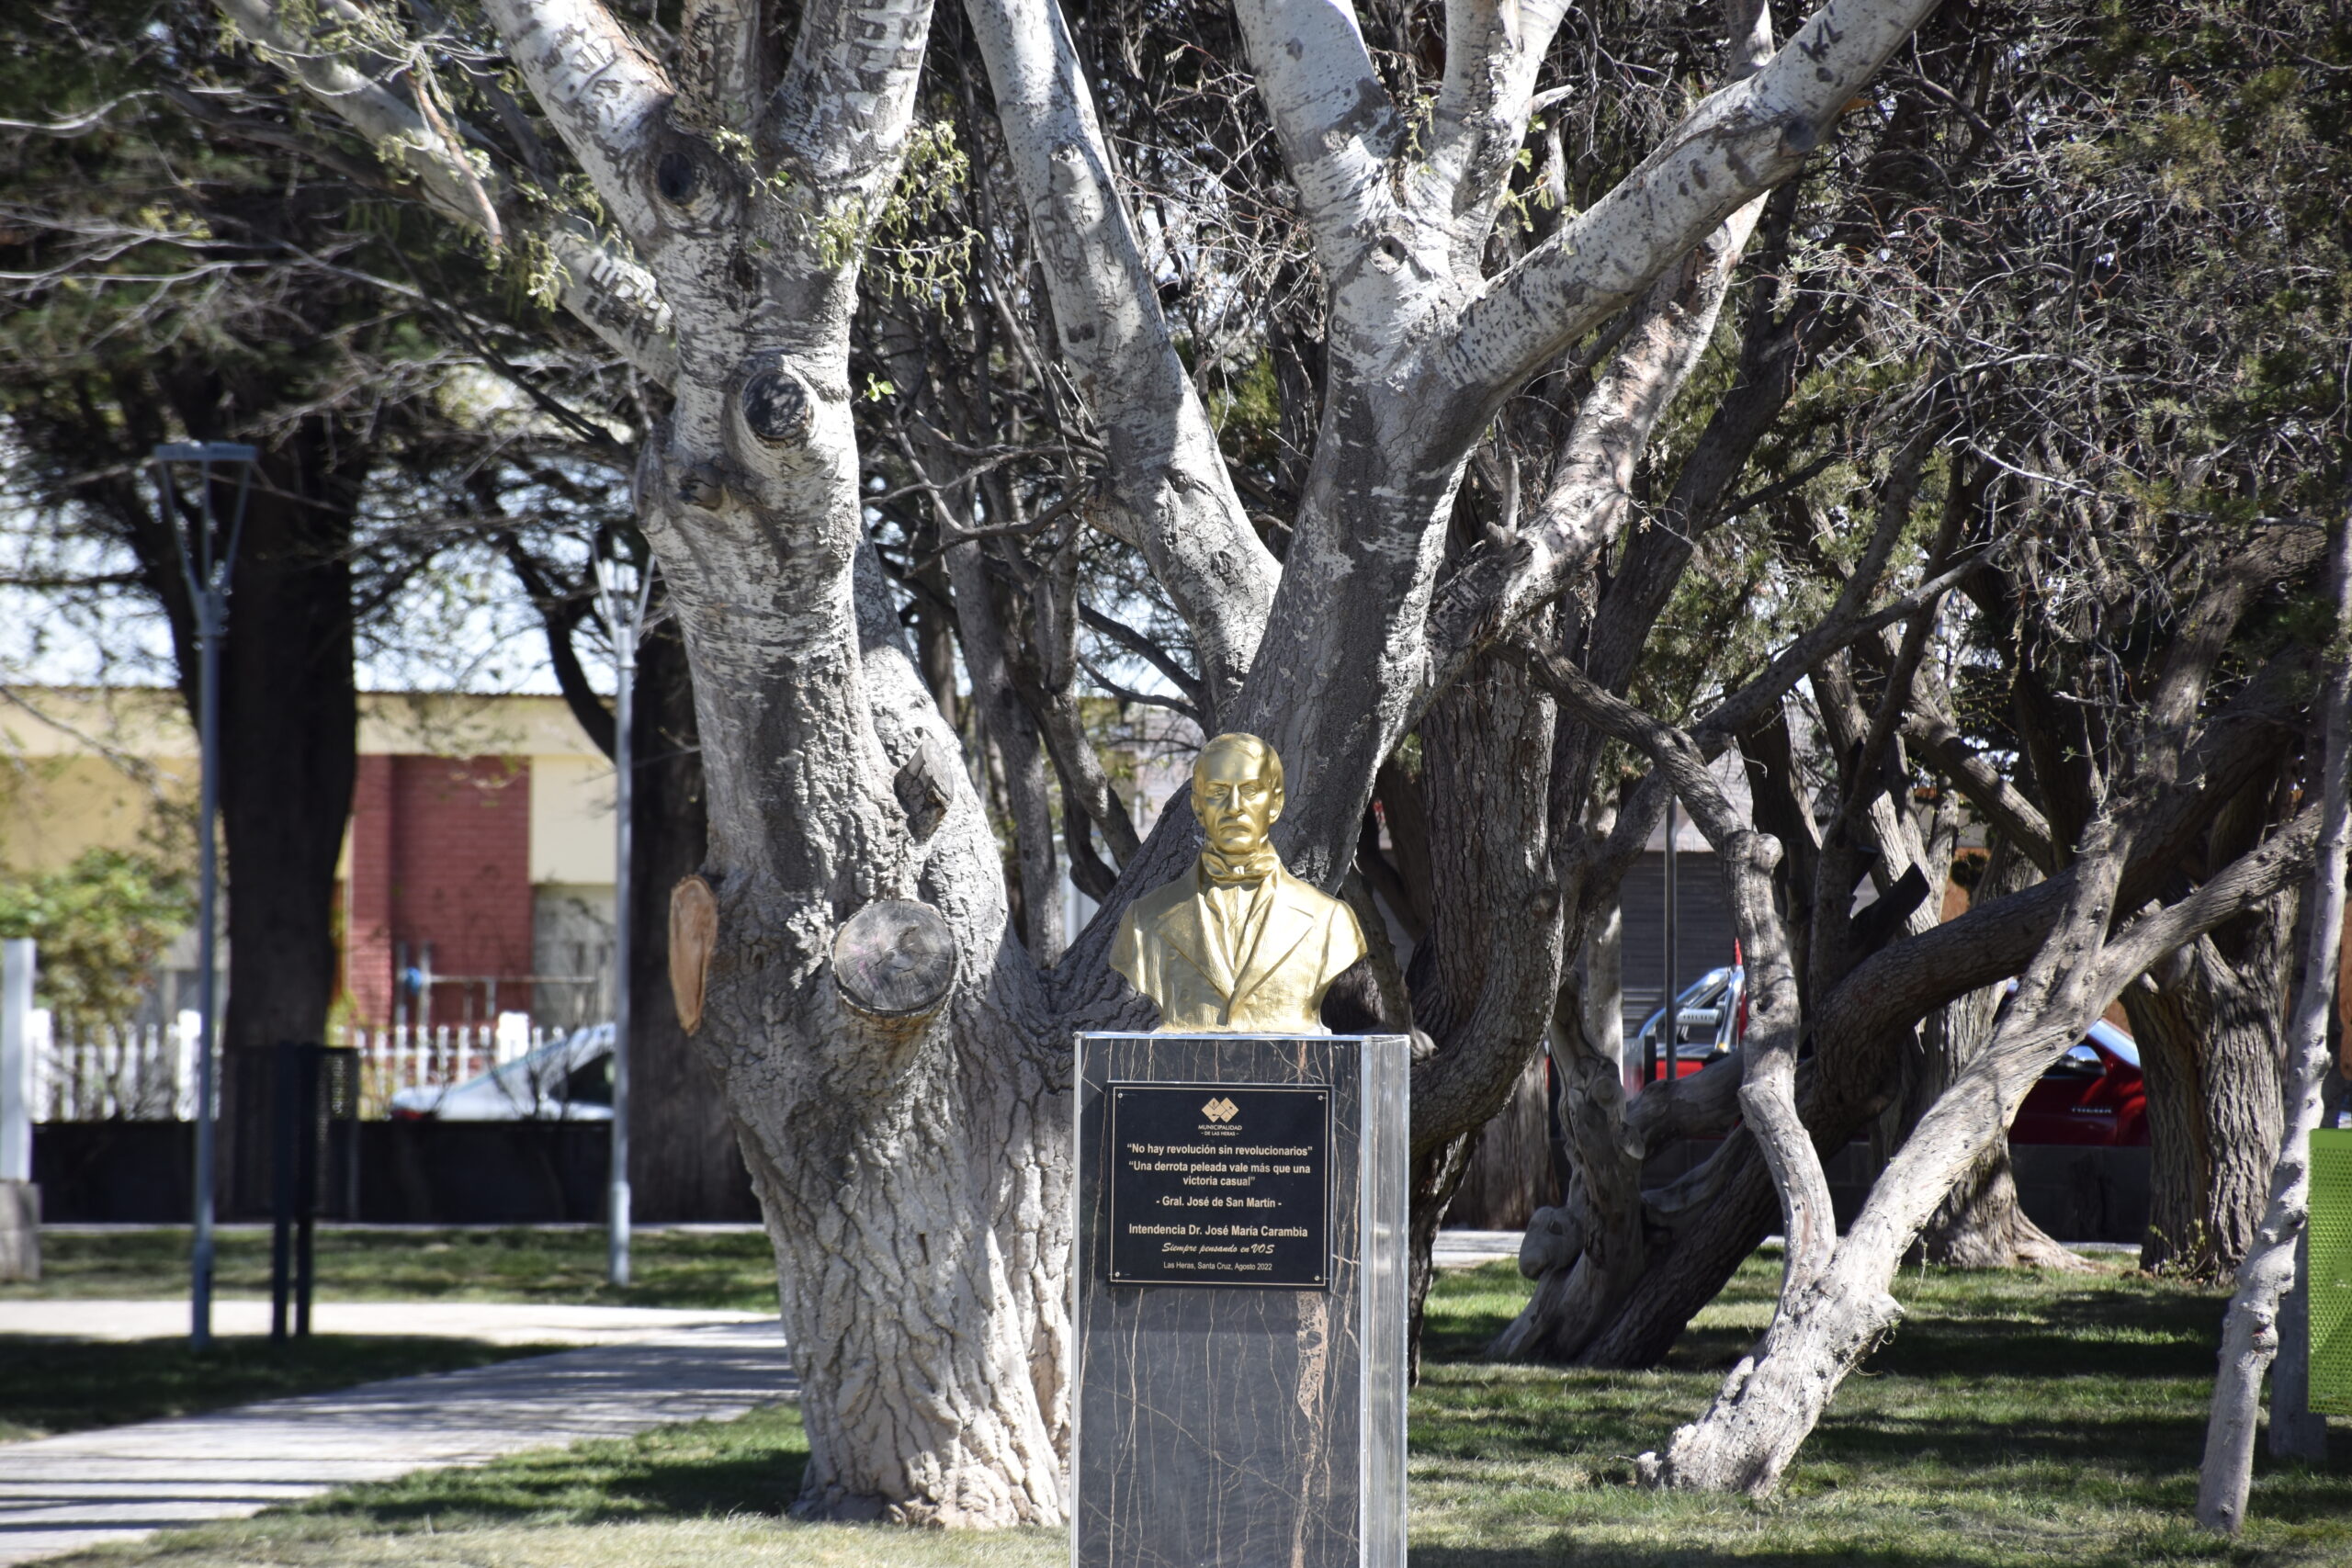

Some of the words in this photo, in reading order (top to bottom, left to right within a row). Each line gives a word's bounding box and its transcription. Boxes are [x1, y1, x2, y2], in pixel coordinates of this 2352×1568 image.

[1148, 1144, 1164, 1156] hay
[1167, 1144, 1216, 1155] revolución
[1218, 1145, 1233, 1155] sin
[1155, 1161, 1188, 1171] derrota
[1191, 1162, 1227, 1173] peleada
[1229, 1163, 1249, 1172] vale
[1251, 1163, 1271, 1172] más
[1273, 1166, 1290, 1175] que
[1183, 1176, 1217, 1185] victoria
[1220, 1177, 1255, 1186] casual”
[1162, 1196, 1184, 1206] Gral.
[1187, 1196, 1209, 1206] José
[1212, 1197, 1223, 1206] de
[1226, 1198, 1243, 1207] San
[1247, 1198, 1275, 1207] Martín
[1129, 1224, 1185, 1235] Intendencia
[1189, 1224, 1202, 1235] Dr.
[1205, 1225, 1228, 1235] José
[1231, 1225, 1258, 1235] María
[1261, 1225, 1307, 1236] Carambia
[1162, 1243, 1197, 1253] Siempre
[1199, 1244, 1238, 1254] pensando
[1251, 1244, 1274, 1254] VOS
[1235, 1263, 1255, 1271] Agosto
